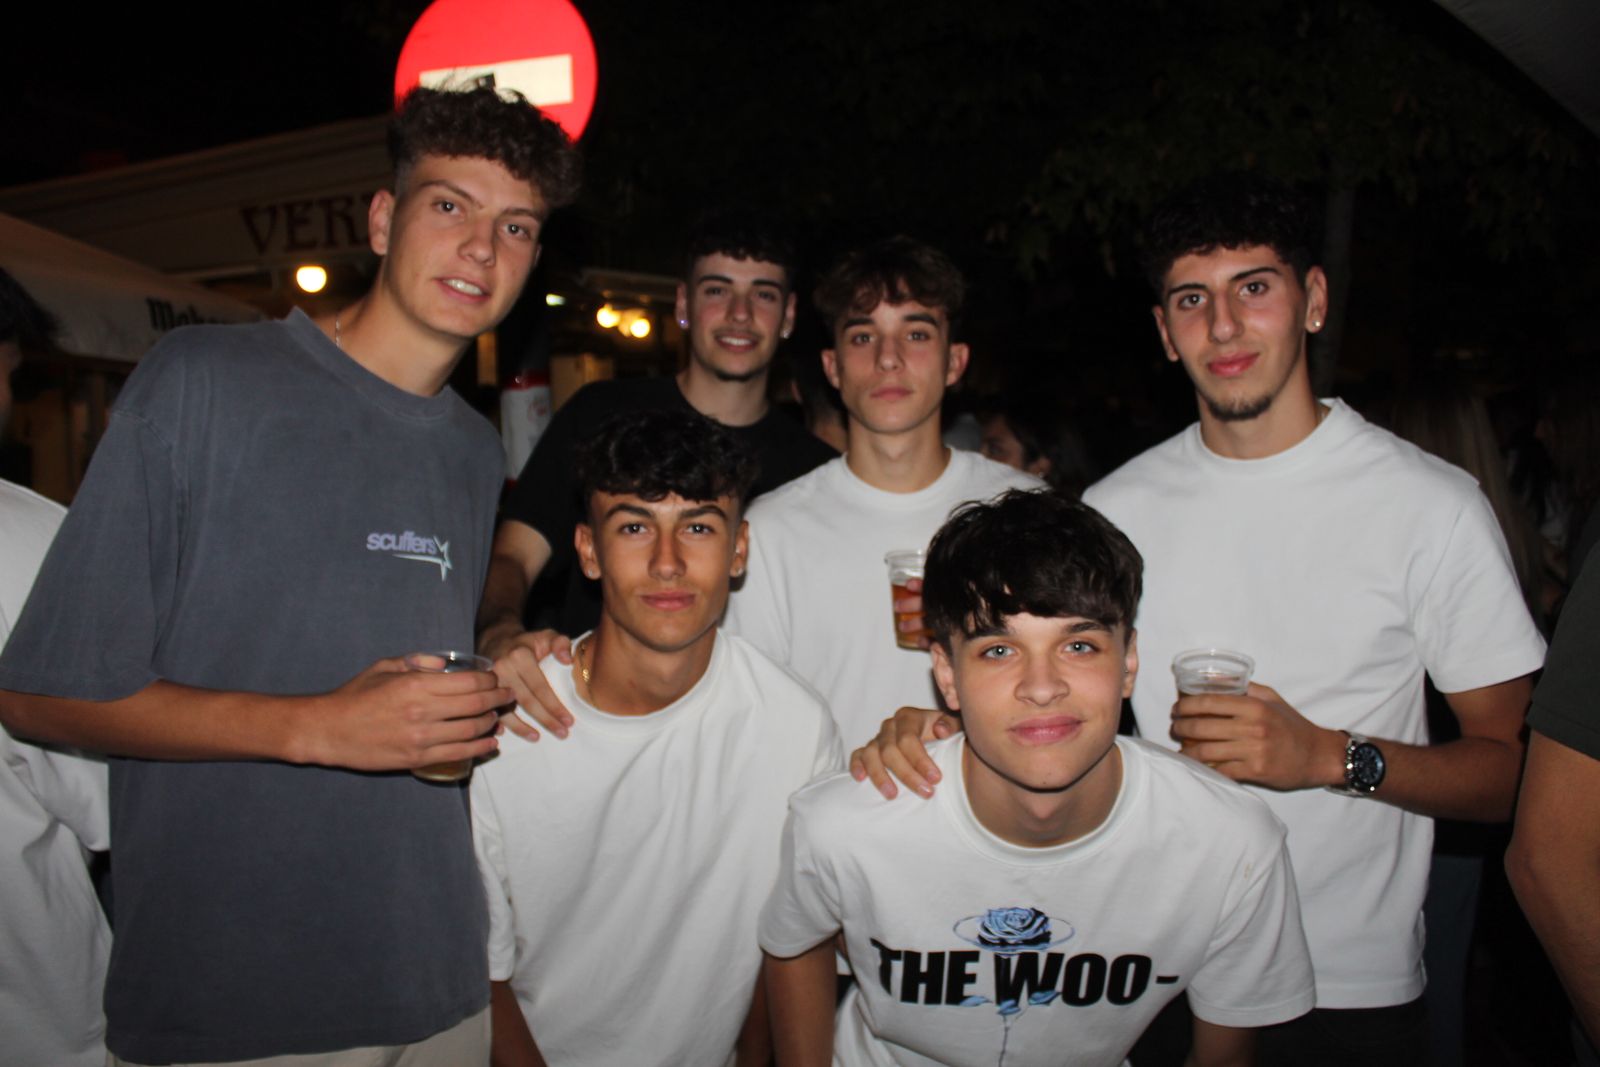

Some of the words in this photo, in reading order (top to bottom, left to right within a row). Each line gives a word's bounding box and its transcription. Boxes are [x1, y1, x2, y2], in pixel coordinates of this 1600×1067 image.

[240, 193, 371, 254] VER
[366, 531, 437, 555] scuffers
[870, 938, 980, 1006] THE
[994, 952, 1179, 1007] WOO-
